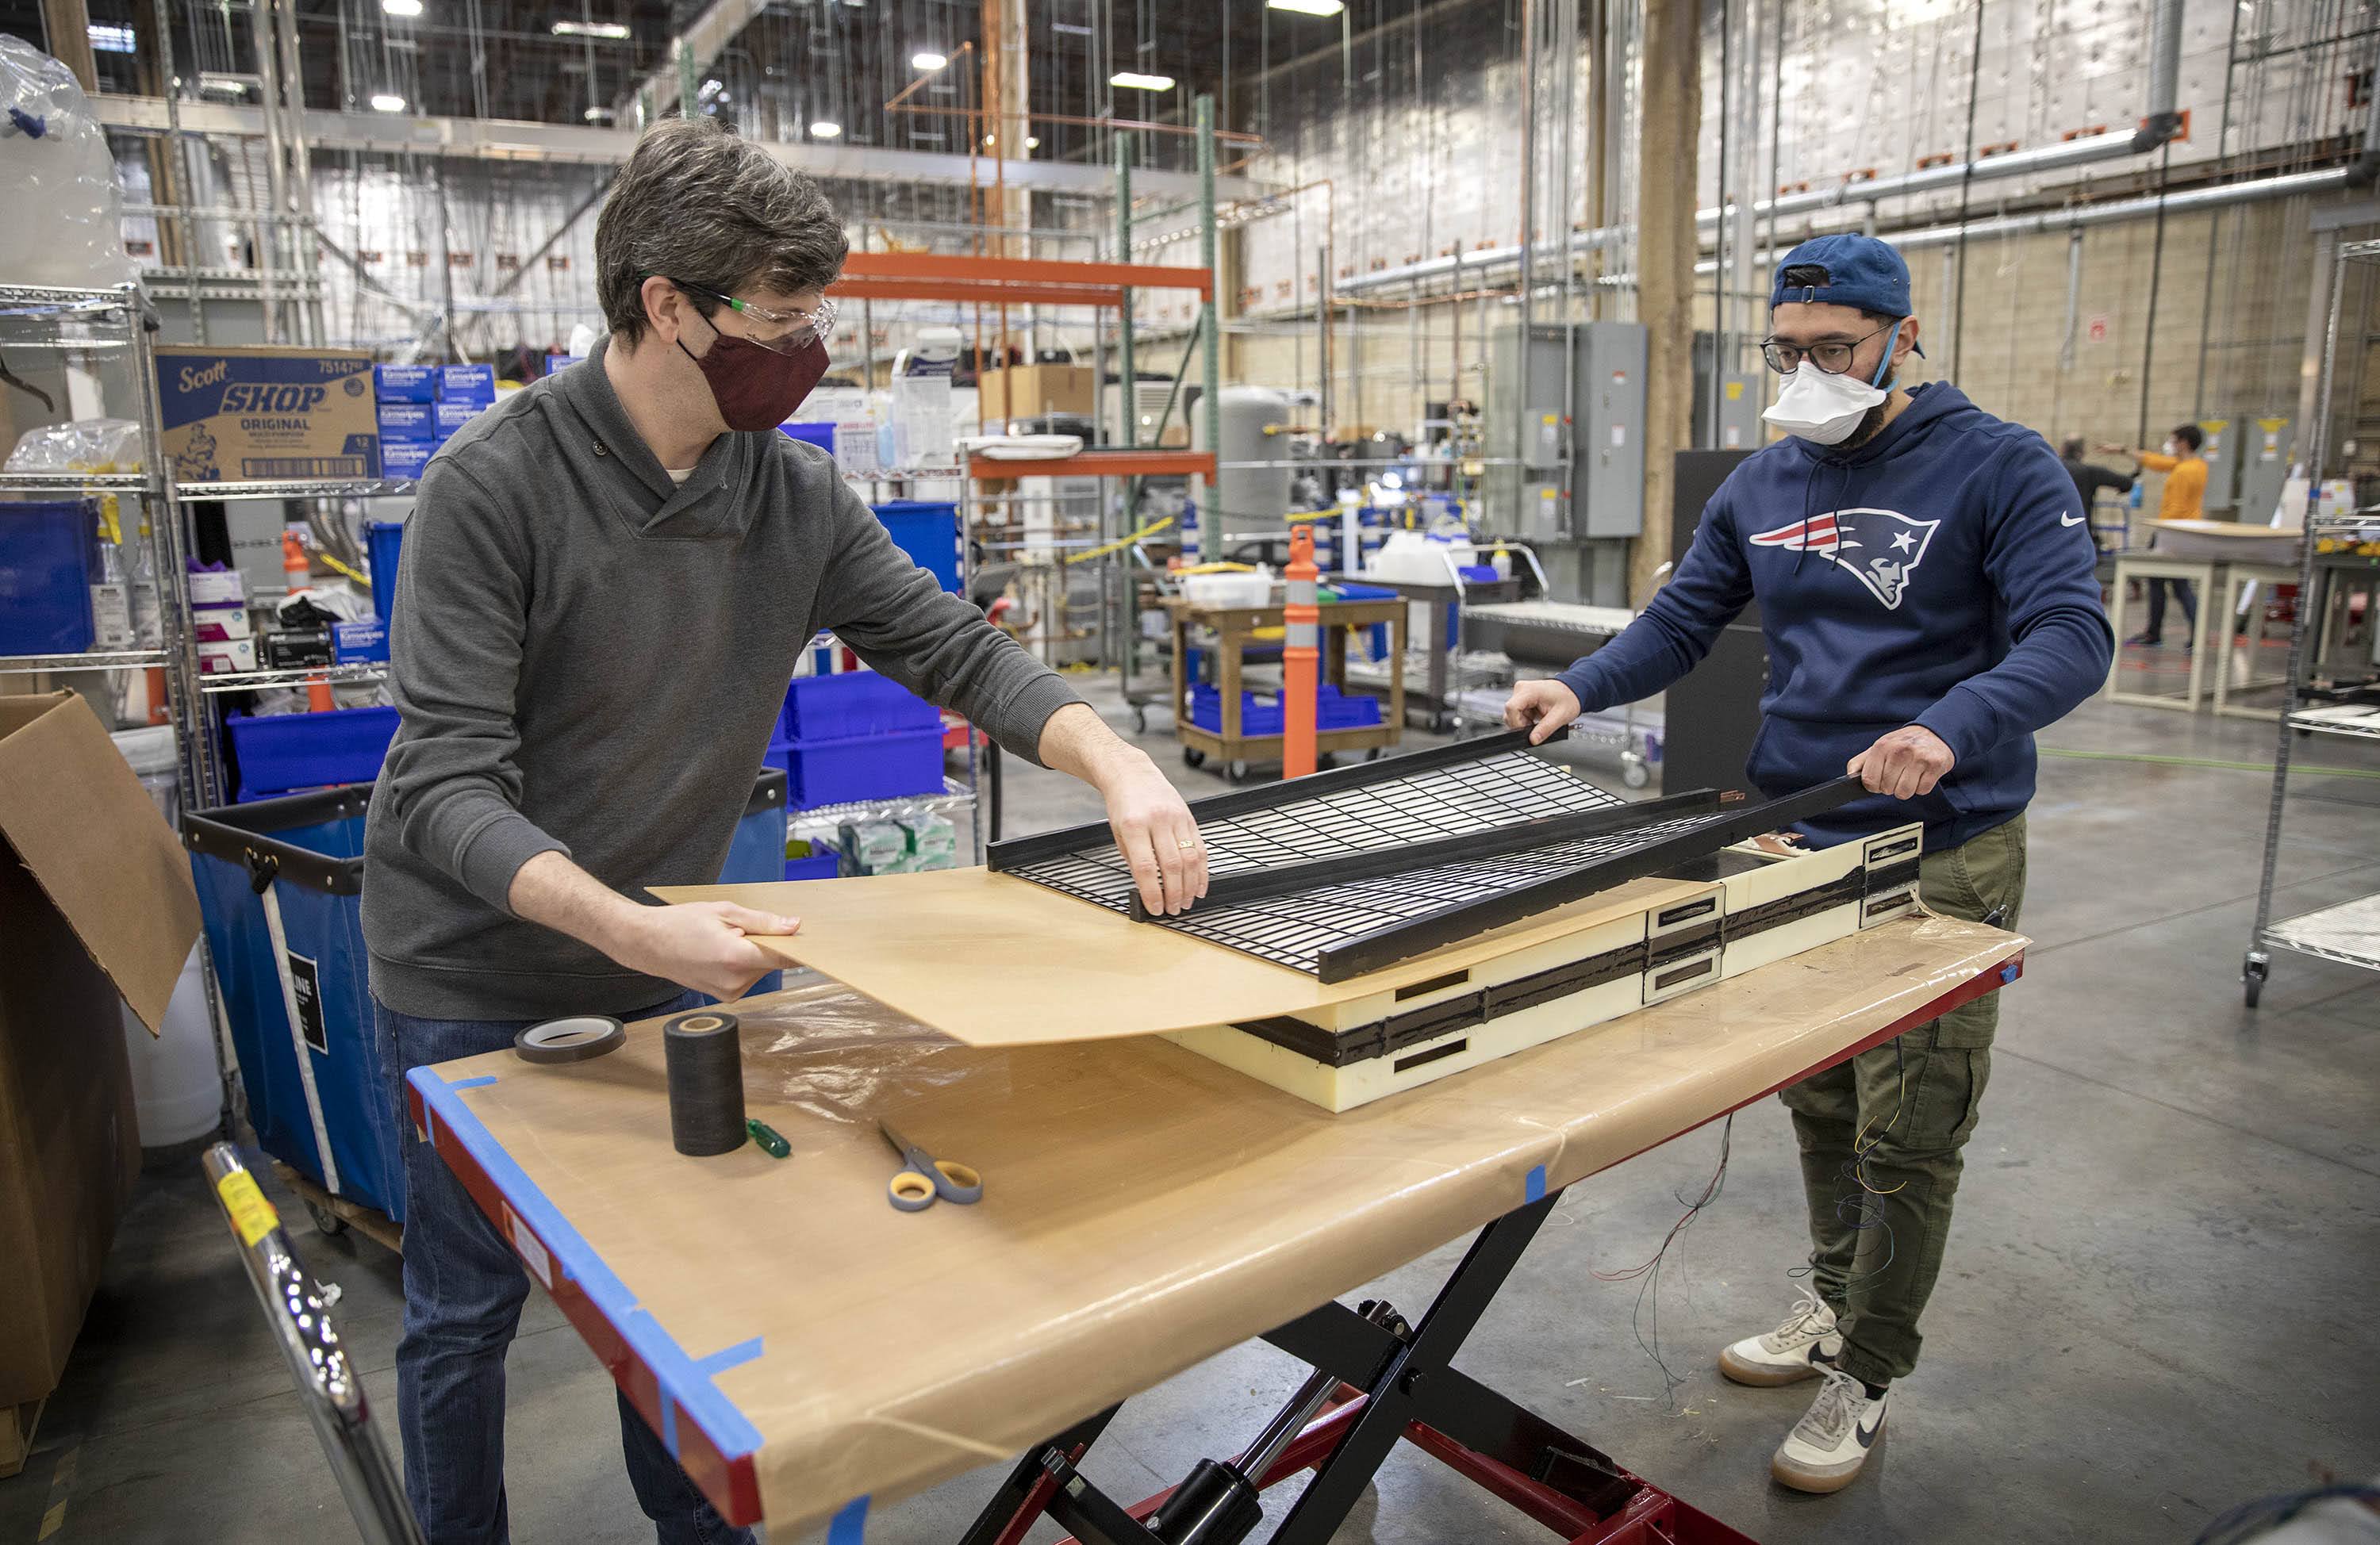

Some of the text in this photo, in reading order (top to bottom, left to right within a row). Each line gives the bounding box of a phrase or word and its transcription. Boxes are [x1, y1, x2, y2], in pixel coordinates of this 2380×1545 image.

[178, 358, 228, 393] Scott
[221, 385, 326, 413] SHOP
[240, 418, 311, 431] ORIGINAL
